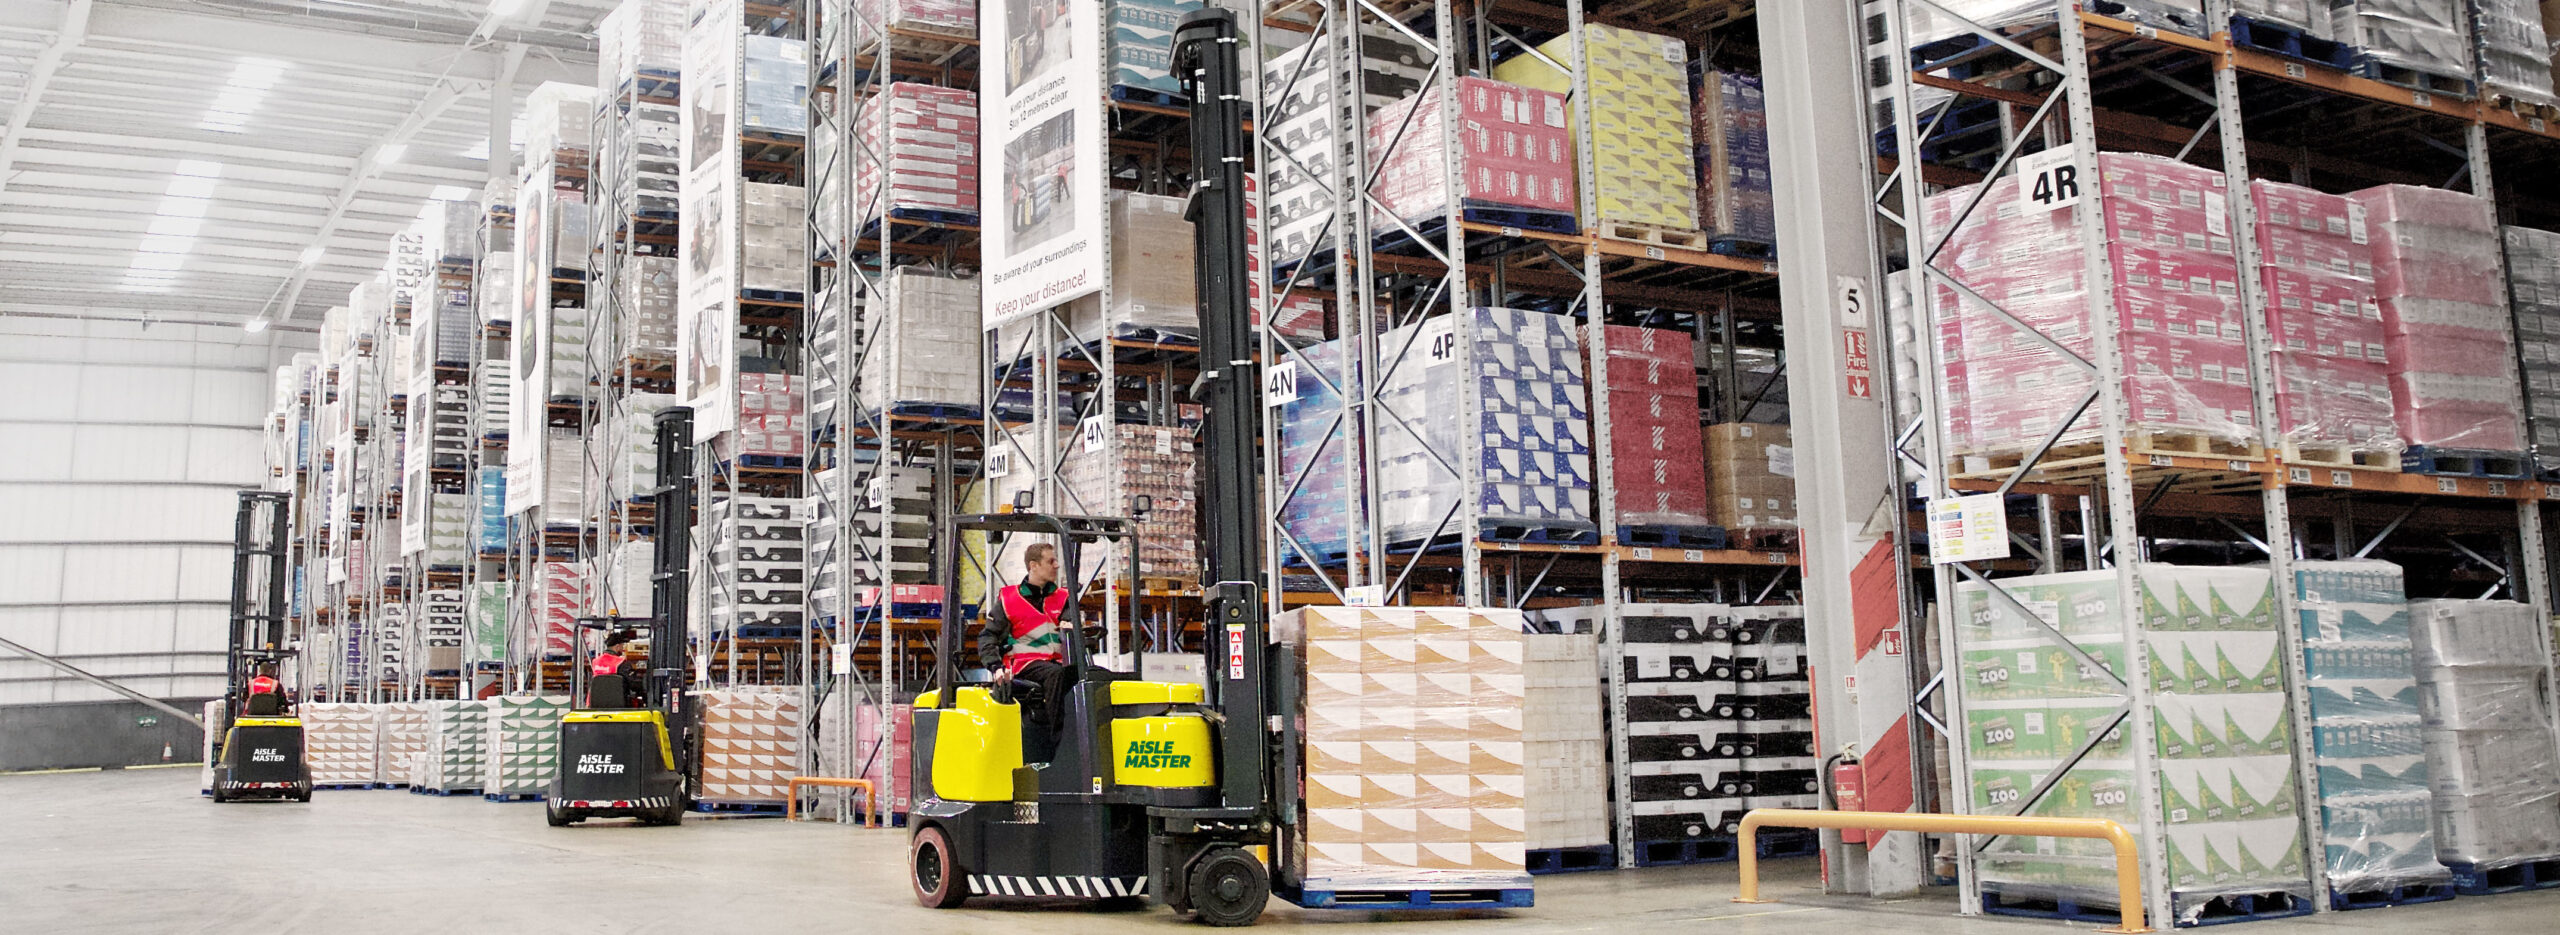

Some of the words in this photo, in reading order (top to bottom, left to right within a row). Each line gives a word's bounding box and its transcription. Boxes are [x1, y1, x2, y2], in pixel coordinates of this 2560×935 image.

[1023, 92, 1036, 107] your
[1037, 76, 1066, 97] distance
[1027, 100, 1049, 118] metres
[1050, 90, 1069, 105] clear
[2032, 165, 2079, 205] 4R
[1647, 247, 1652, 256] E
[994, 274, 1002, 285] Be
[1003, 267, 1021, 281] aware
[1022, 261, 1029, 273] of
[1029, 257, 1043, 273] your
[1044, 239, 1087, 264] surroundings
[995, 298, 1018, 317] Keep
[1020, 290, 1040, 312] your
[1042, 268, 1087, 299] distance!
[1848, 288, 1860, 313] 5
[1432, 333, 1454, 360] 4P
[1846, 353, 1867, 368] Fire
[1269, 368, 1293, 398] 4N
[989, 454, 1006, 474] 4M
[2292, 470, 2298, 482] A
[1634, 550, 1640, 558] A
[1685, 551, 1691, 560] C
[1769, 554, 1775, 562] D
[1974, 608, 2002, 625] ZOO
[2075, 600, 2106, 618] ZOO
[1979, 667, 2009, 684] ZOO
[1986, 727, 2015, 744] ZOO
[1127, 740, 1175, 754] AiSLE
[579, 754, 612, 764] AiSLE
[1124, 755, 1192, 768] MASTER
[577, 764, 625, 774] MASTER
[1989, 788, 2019, 804] ZOO
[2093, 790, 2126, 806] ZOO
